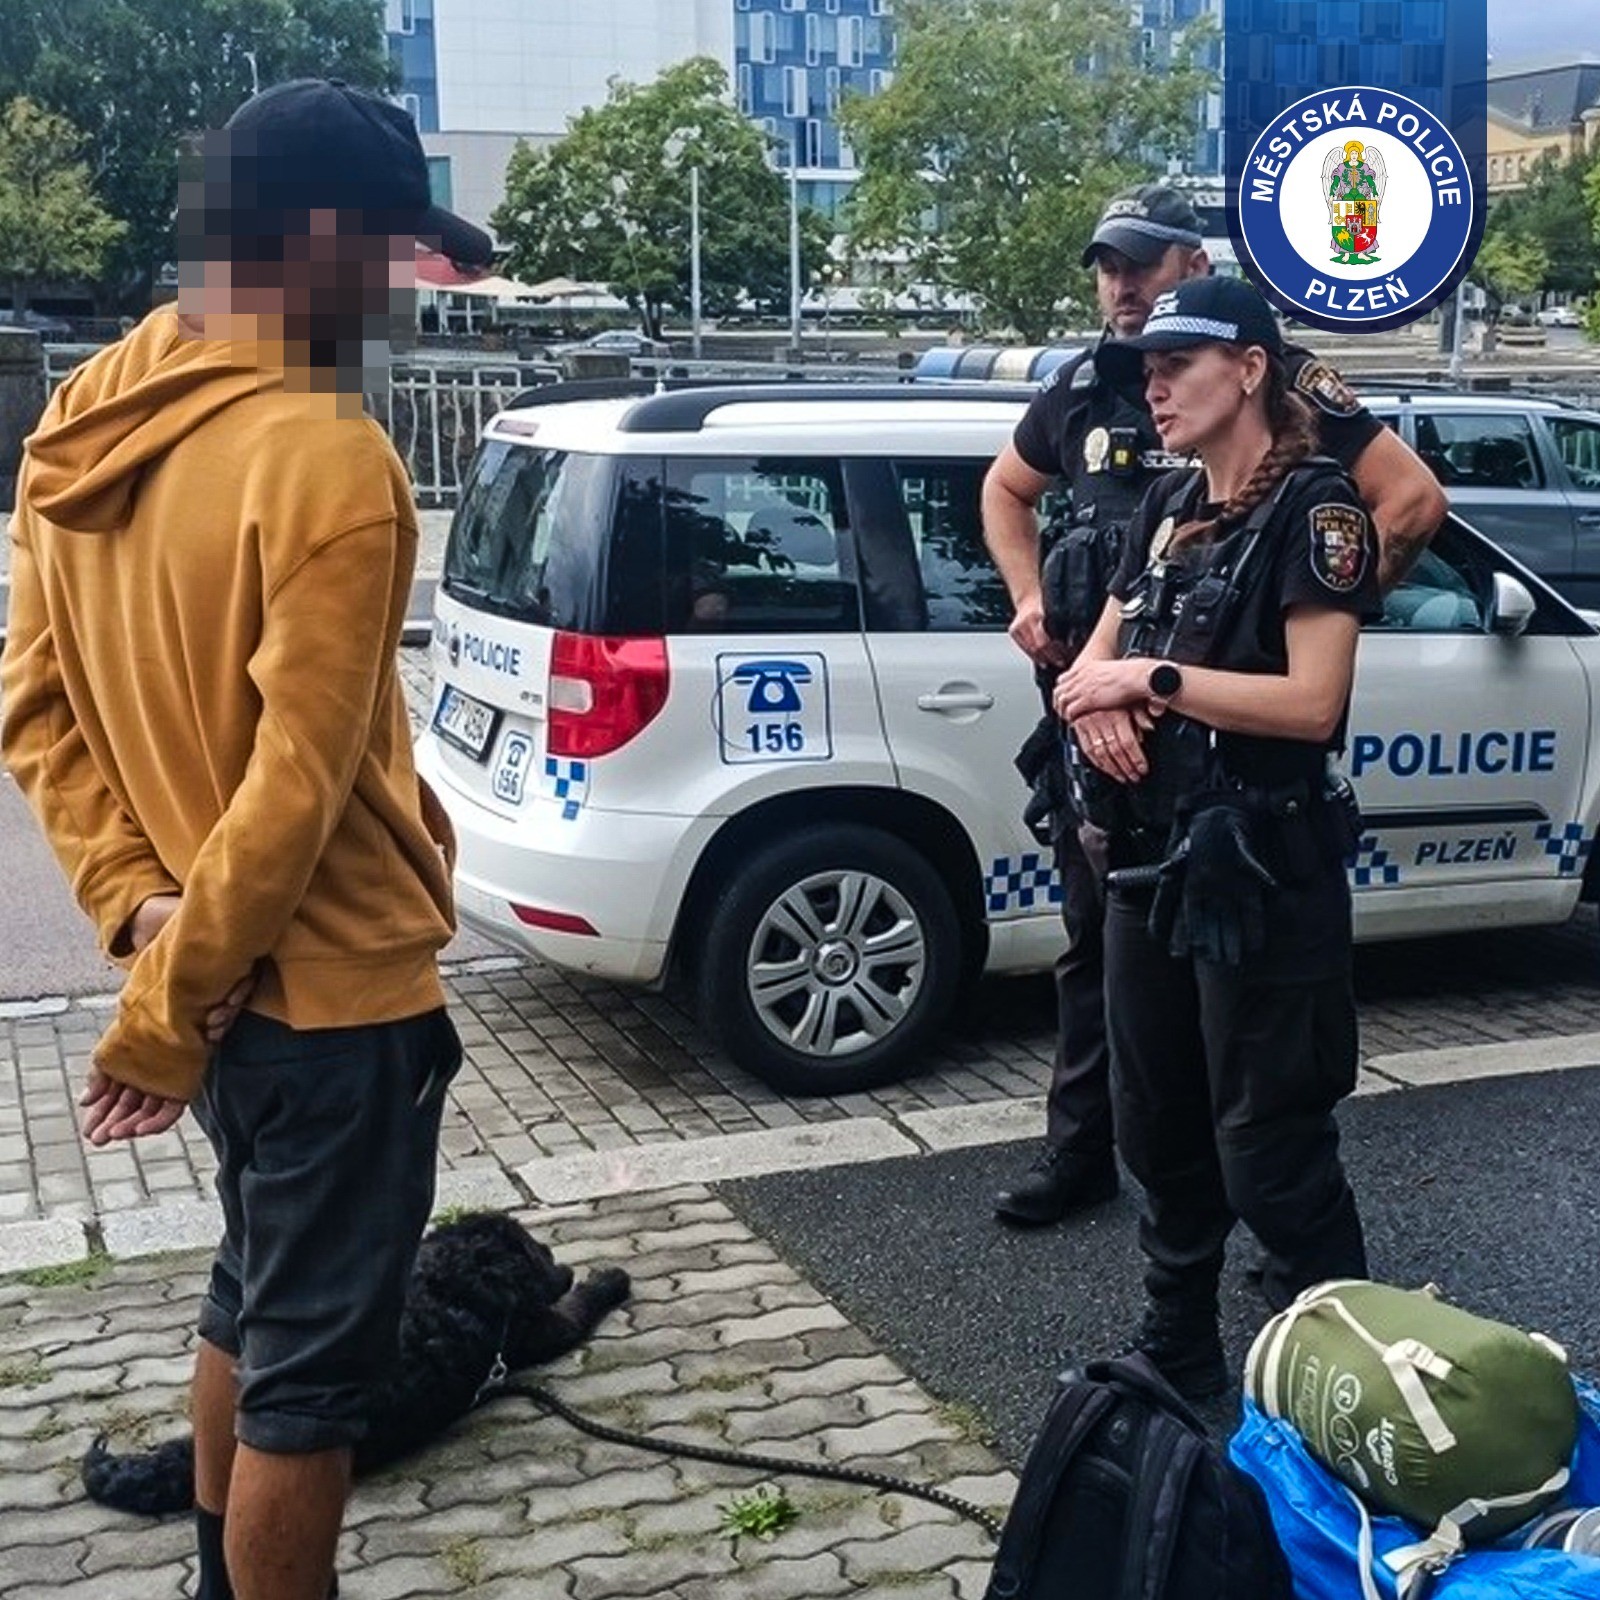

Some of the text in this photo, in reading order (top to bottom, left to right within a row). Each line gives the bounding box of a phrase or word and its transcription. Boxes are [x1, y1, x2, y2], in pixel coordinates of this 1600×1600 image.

[464, 633, 520, 675] POLICIE
[746, 722, 803, 752] 156
[1351, 731, 1556, 777] POLICIE
[499, 768, 520, 796] 156
[1415, 831, 1516, 865] PLZEŇ
